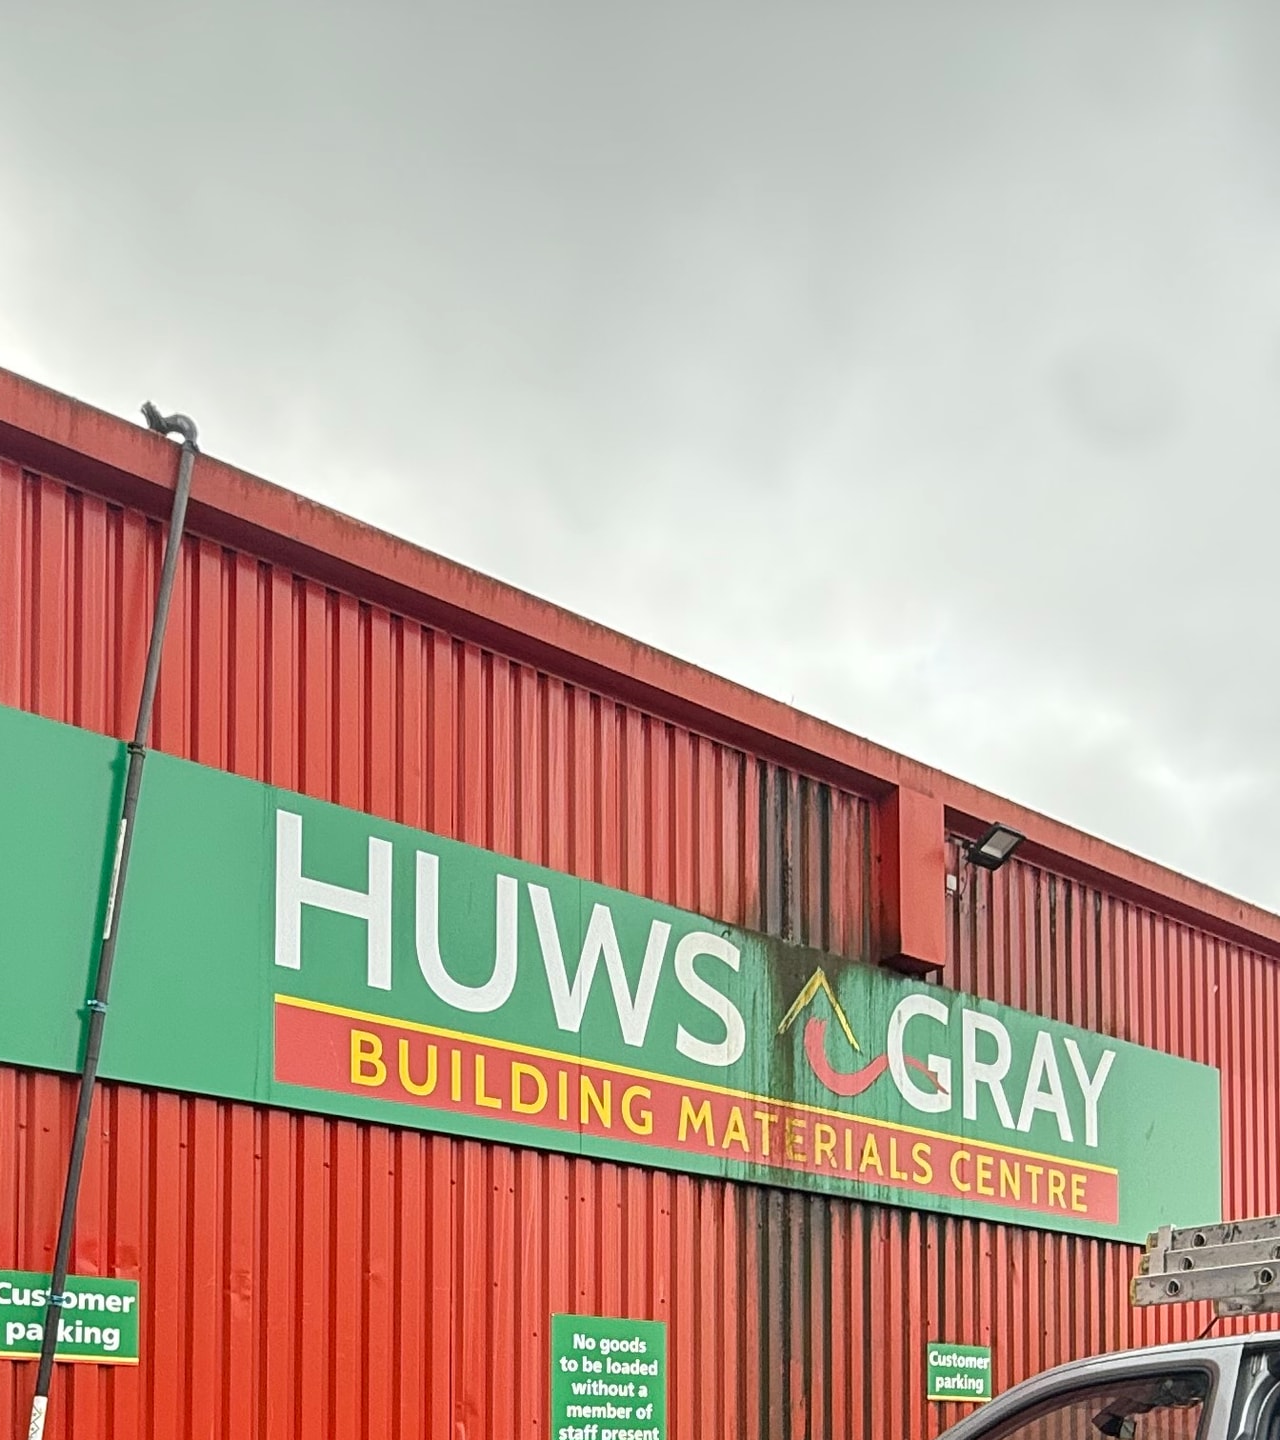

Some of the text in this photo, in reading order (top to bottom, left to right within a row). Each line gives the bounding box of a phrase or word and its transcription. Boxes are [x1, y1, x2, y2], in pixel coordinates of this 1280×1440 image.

[274, 808, 745, 1067] HUWS
[888, 993, 1116, 1149] GRAY
[349, 1029, 1089, 1213] BUILDING MATERIALS CENTRE
[6, 1319, 120, 1351] paking
[573, 1333, 647, 1355] No goods
[560, 1356, 658, 1376] to be loaded
[929, 1351, 990, 1369] Customer
[571, 1379, 648, 1397] without a
[935, 1373, 984, 1394] parking
[566, 1403, 653, 1419] member of
[559, 1424, 598, 1440] staff
